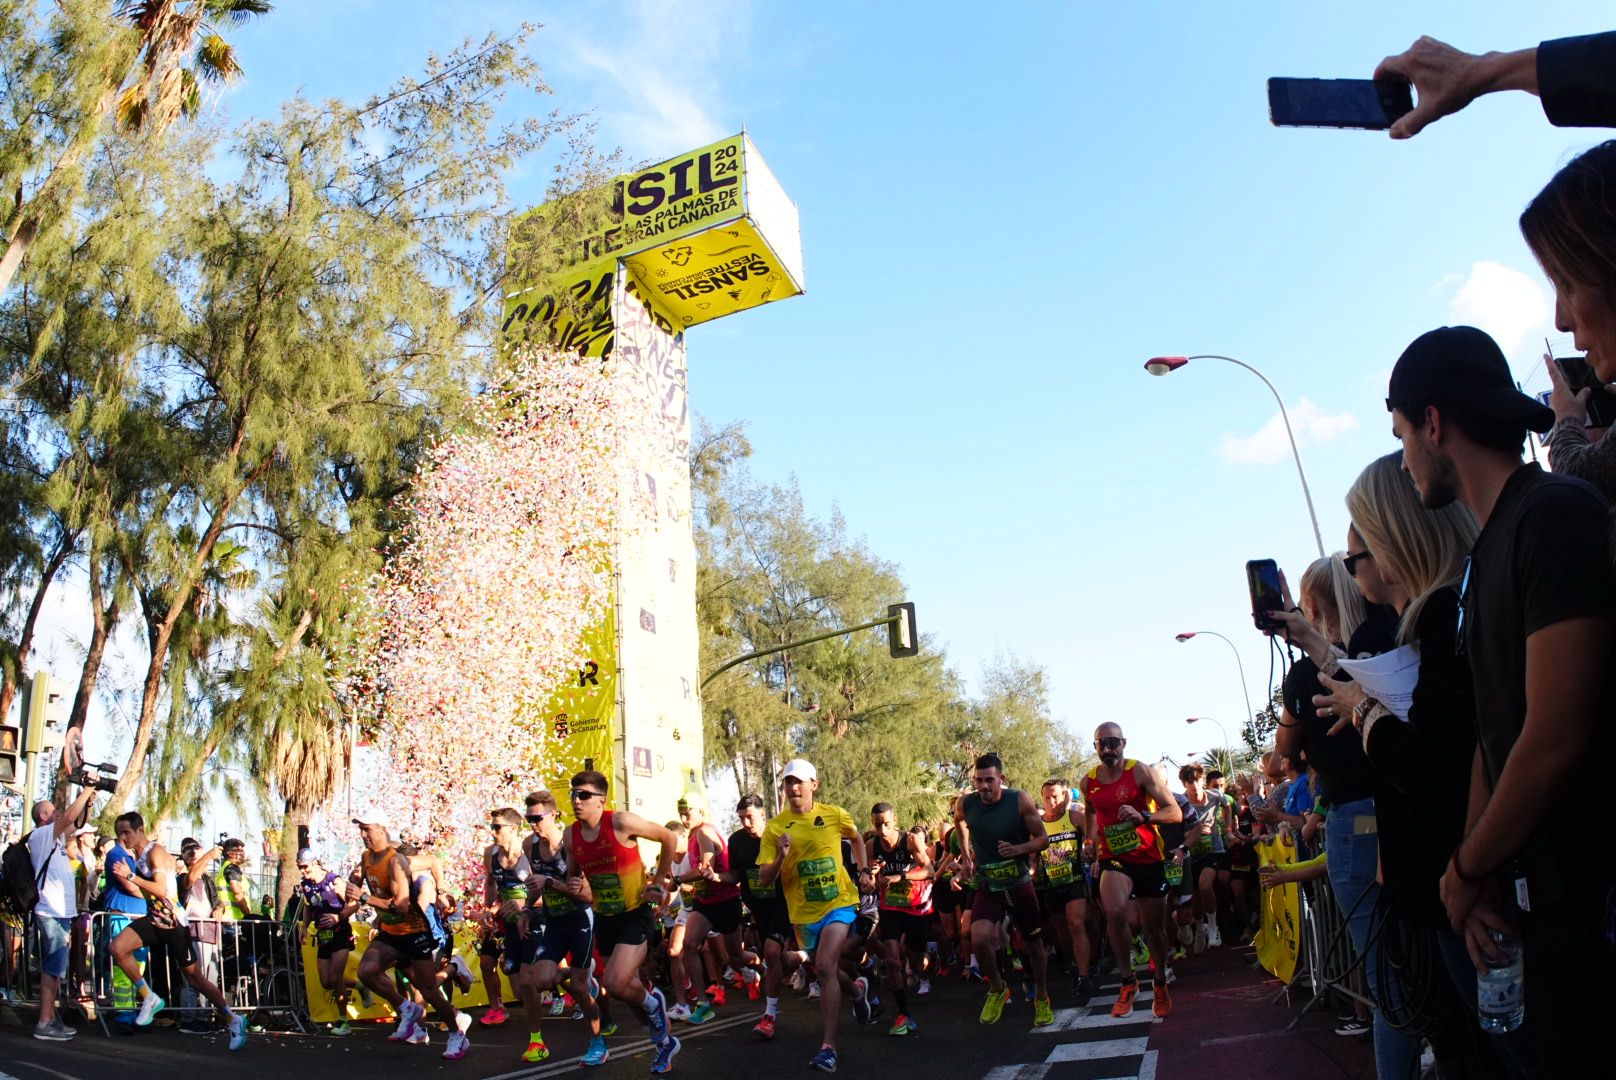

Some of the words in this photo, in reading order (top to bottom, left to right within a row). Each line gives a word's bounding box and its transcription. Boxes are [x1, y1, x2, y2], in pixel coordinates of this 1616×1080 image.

[714, 145, 737, 162] 20
[714, 159, 739, 176] 24
[624, 215, 652, 235] LAS
[655, 193, 715, 223] PALMAS
[718, 186, 738, 202] DE
[667, 198, 738, 230] CANARIA
[703, 252, 762, 278] VESTRE
[663, 260, 770, 301] SANSIL
[570, 717, 600, 728] Gobierno
[577, 723, 607, 734] Canarias
[1110, 831, 1138, 849] 5050
[807, 874, 835, 888] 8494
